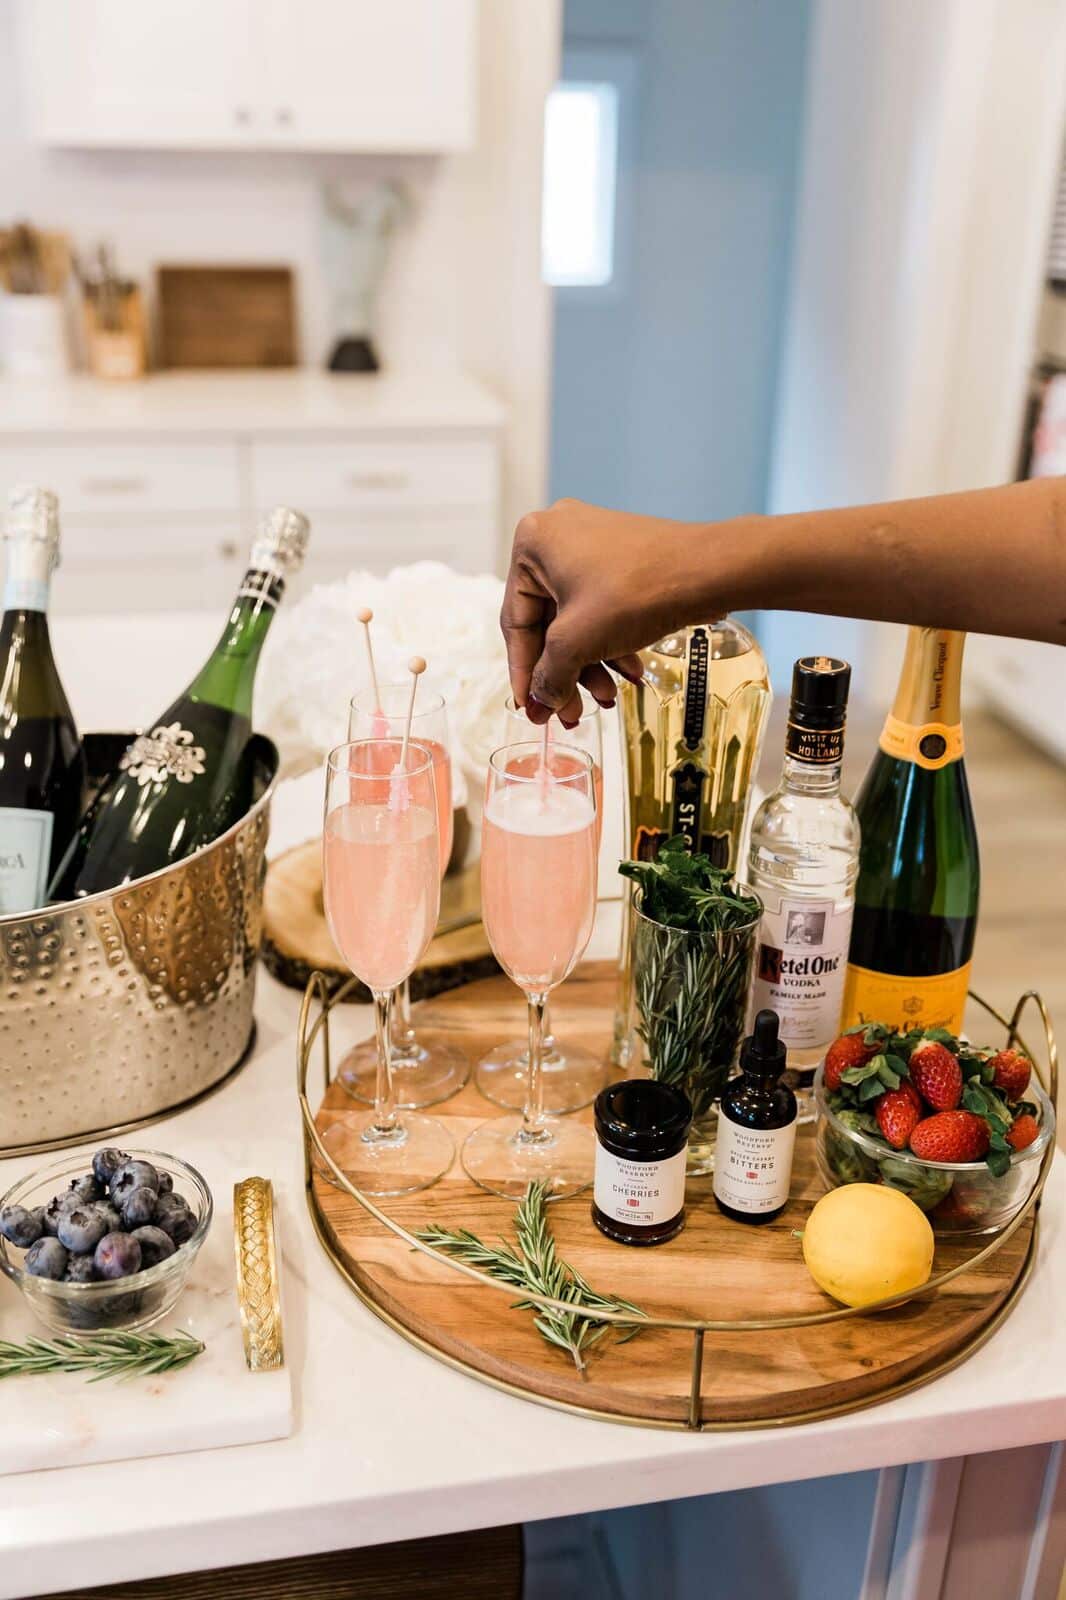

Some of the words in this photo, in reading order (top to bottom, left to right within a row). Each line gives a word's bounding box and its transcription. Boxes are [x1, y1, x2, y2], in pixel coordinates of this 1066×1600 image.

[699, 643, 707, 654] LA
[698, 656, 707, 673] VIE
[801, 734, 828, 743] VISIT
[798, 745, 840, 757] HOLLAND
[759, 946, 809, 976] Ketel
[811, 956, 840, 975] One
[783, 978, 822, 988] VODKA
[770, 989, 802, 1000] FAMILY
[730, 1156, 775, 1170] BITTERS
[612, 1184, 660, 1198] CHERRIES
